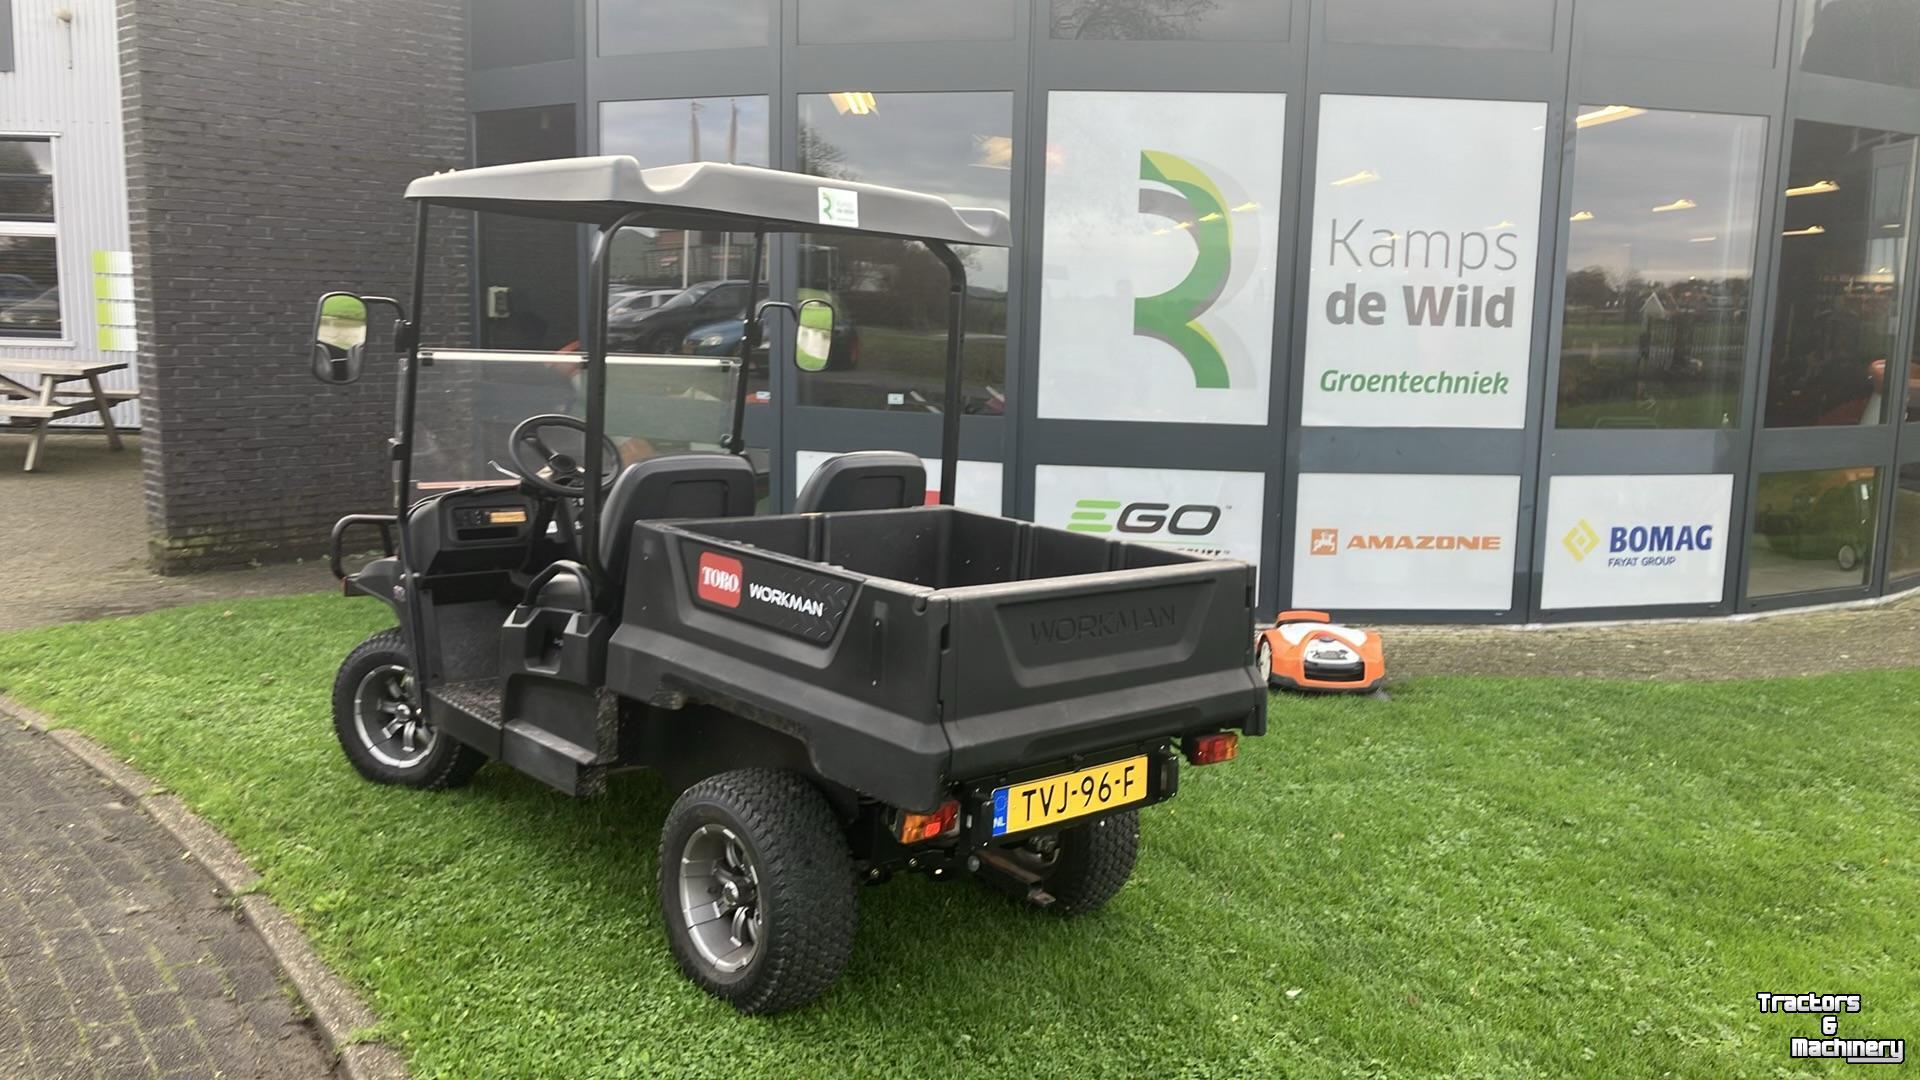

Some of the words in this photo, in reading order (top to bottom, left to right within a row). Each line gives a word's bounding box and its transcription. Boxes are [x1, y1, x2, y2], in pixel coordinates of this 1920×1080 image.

[1329, 218, 1518, 277] Kamps
[1325, 282, 1387, 326] de
[1402, 284, 1516, 328] Wild
[1320, 369, 1510, 394] Groentechniek
[1066, 500, 1222, 536] EGO
[1346, 534, 1502, 550] AMAZONE
[1609, 525, 1713, 553] BOMAG
[1608, 557, 1638, 568] FAYAT
[1641, 556, 1676, 567] GROUP
[702, 566, 740, 593] TORO
[749, 582, 824, 617] WORKMAN
[1029, 603, 1176, 646] WORKMAN
[1022, 765, 1135, 822] TVJ-96-F
[993, 817, 1006, 828] NL
